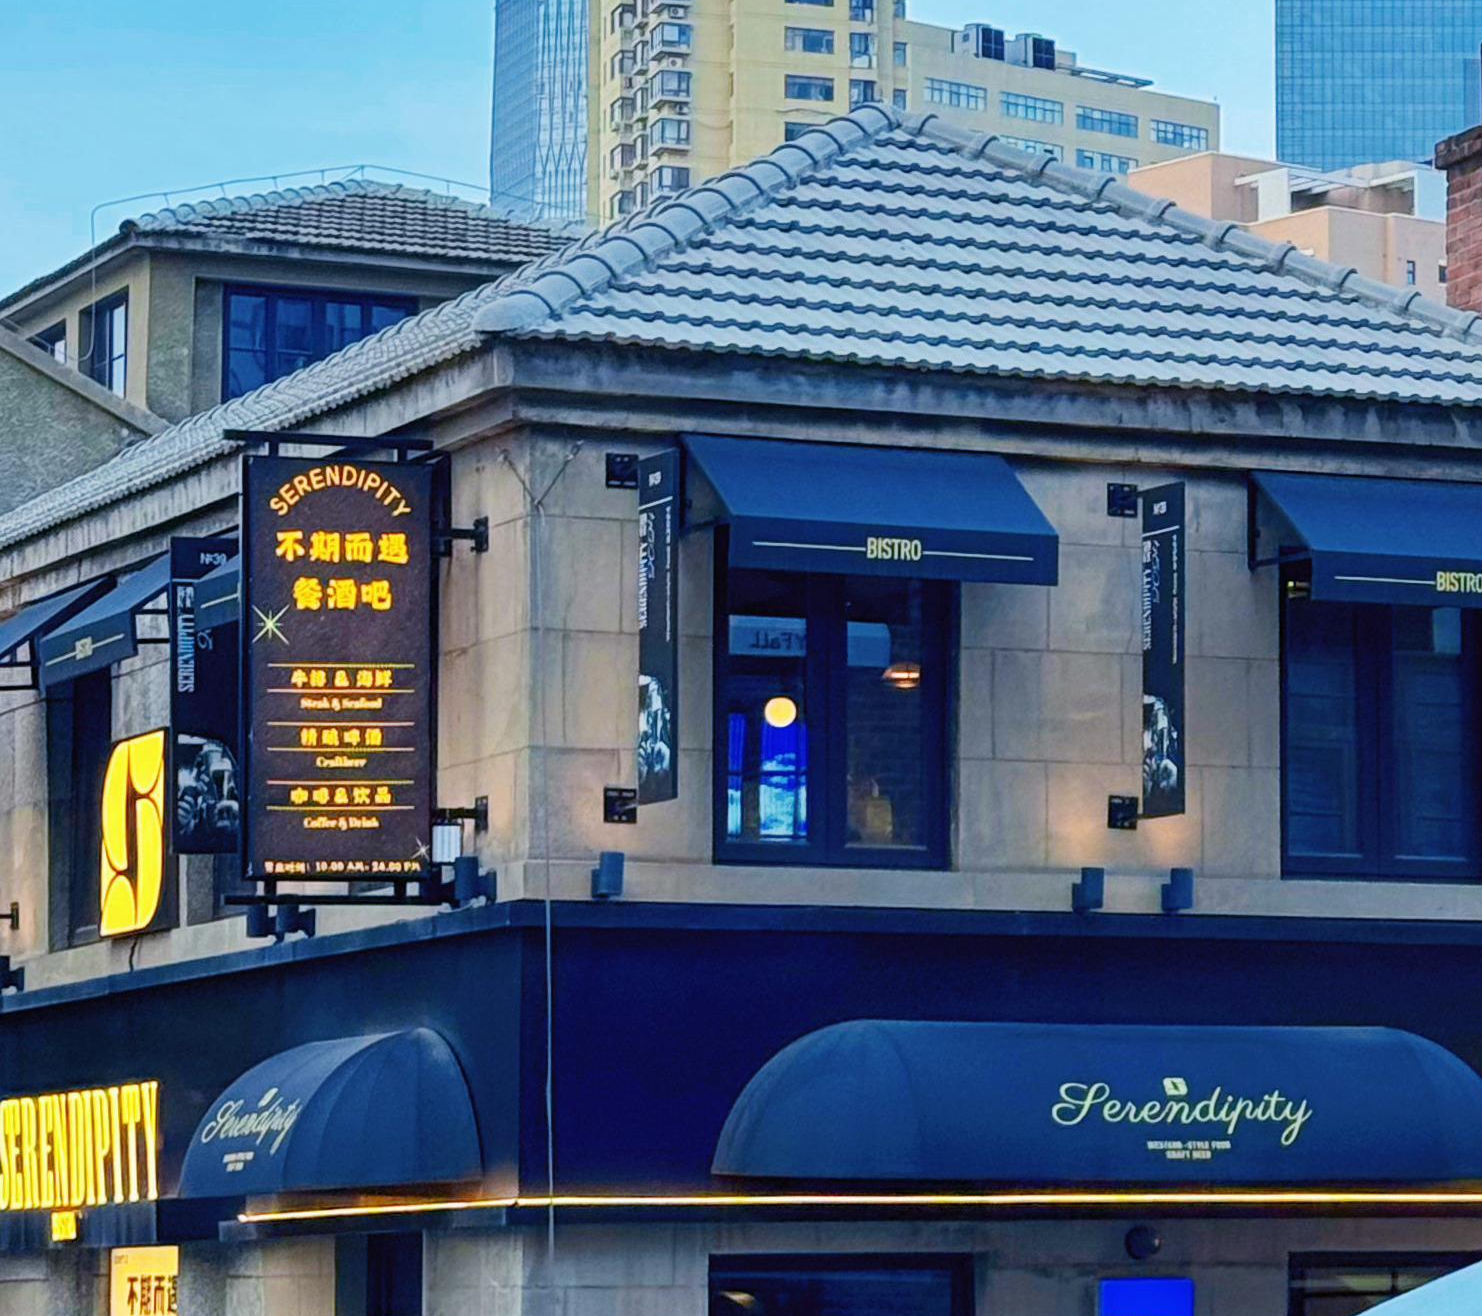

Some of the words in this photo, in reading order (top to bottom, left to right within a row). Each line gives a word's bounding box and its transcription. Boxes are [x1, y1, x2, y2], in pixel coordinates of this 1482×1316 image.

[269, 465, 412, 517] SERENDIPITY
[275, 530, 410, 565] 不期而遇
[866, 537, 922, 561] BISTRO
[292, 576, 393, 610] 餐酒吧
[201, 1096, 303, 1156] Serendipity
[1052, 1083, 1312, 1146] Serendipity
[0, 1080, 158, 1211] SERENDIPITY
